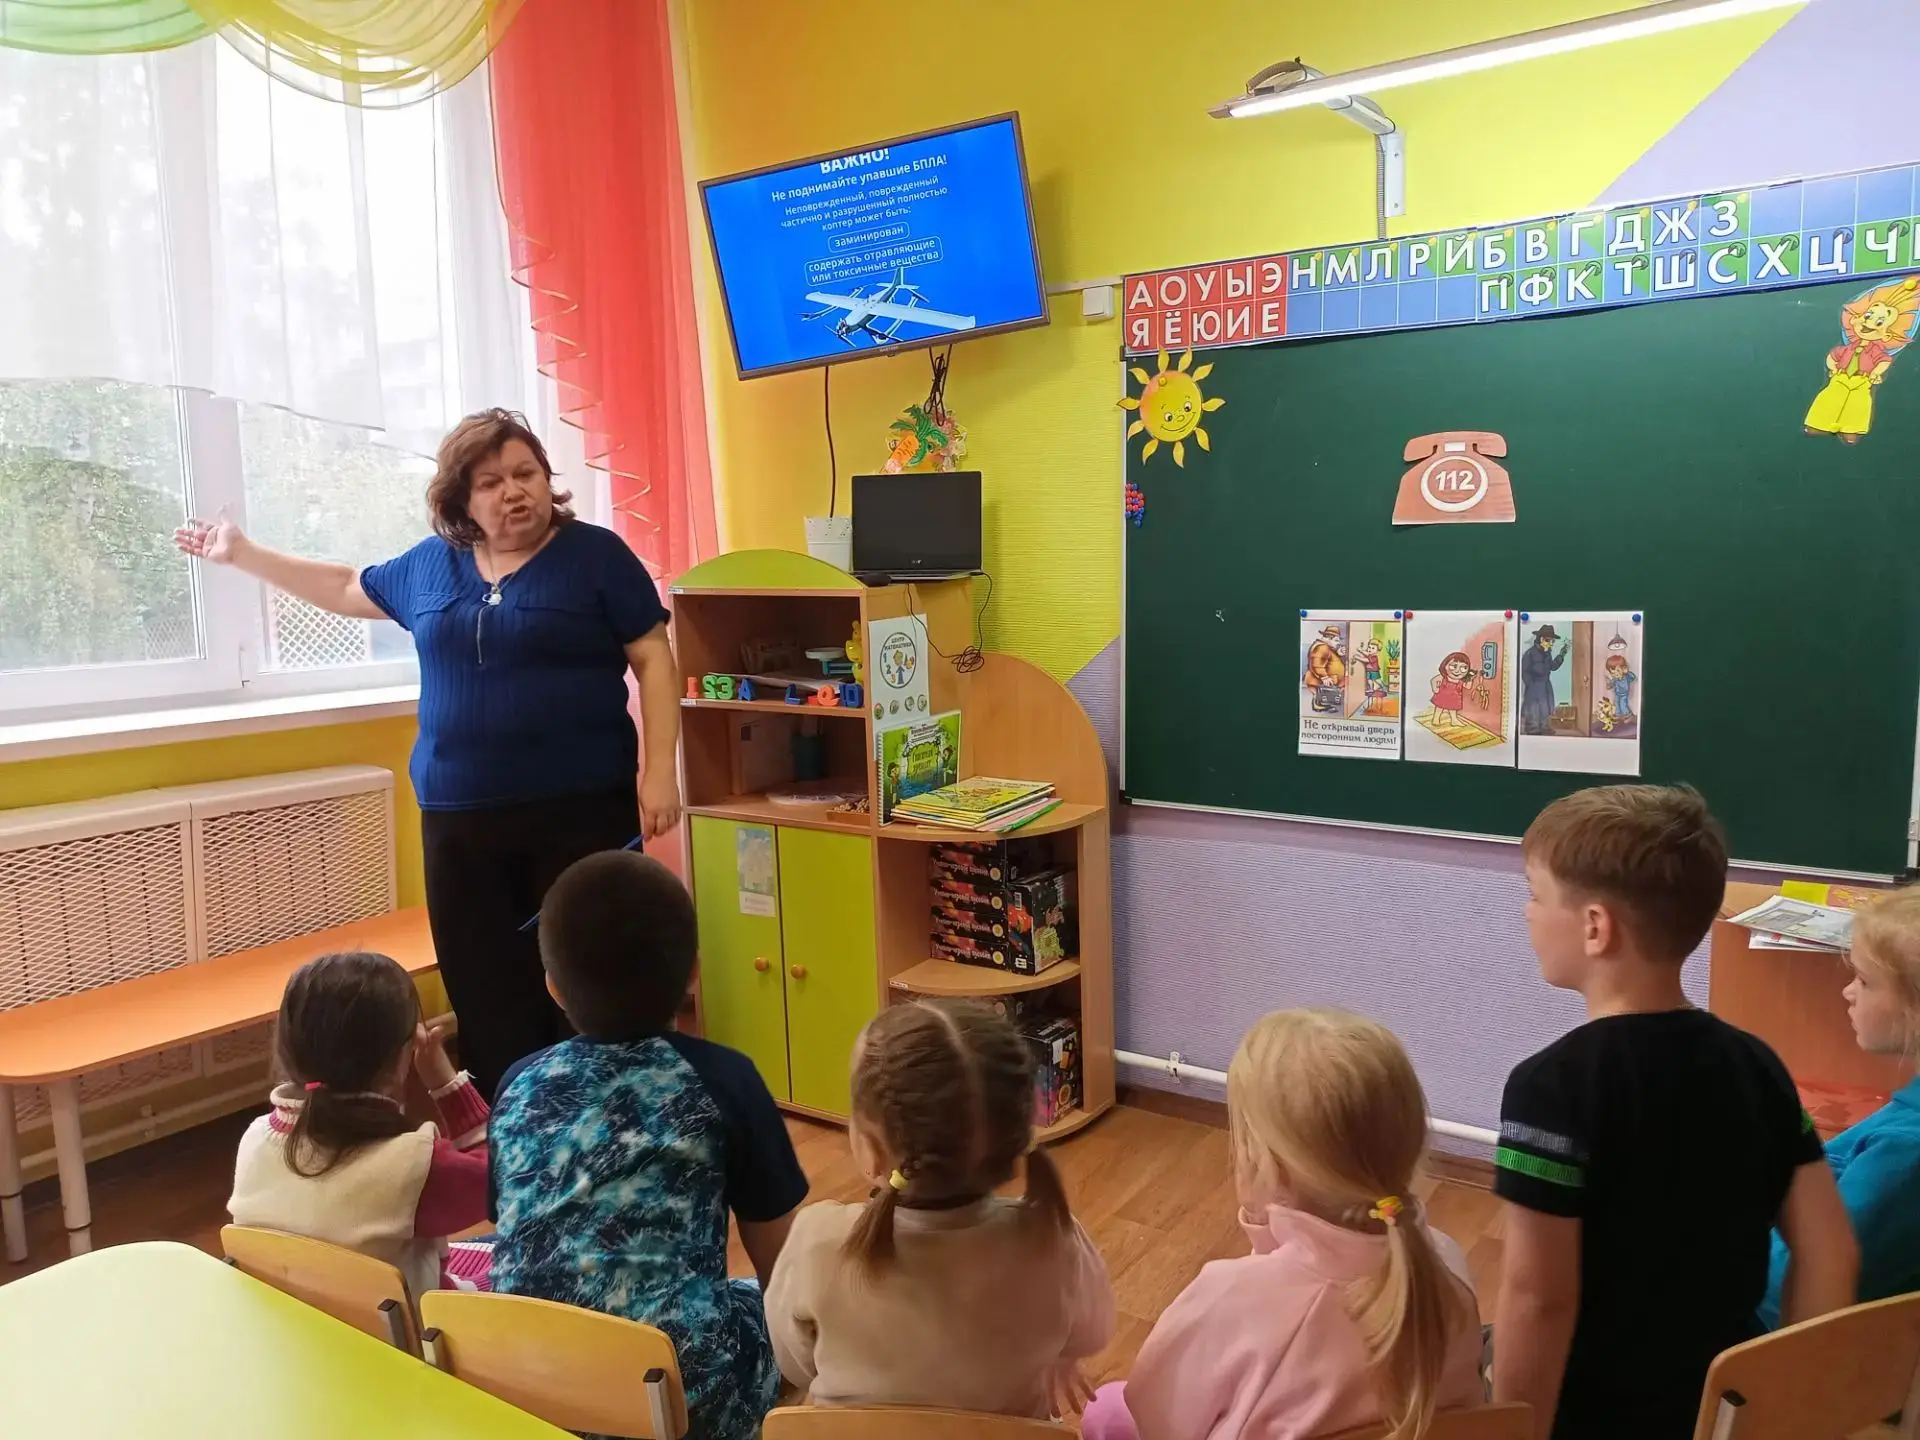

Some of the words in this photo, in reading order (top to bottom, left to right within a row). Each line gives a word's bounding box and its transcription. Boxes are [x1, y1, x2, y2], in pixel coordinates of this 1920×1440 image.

[820, 148, 890, 174] ВАЖНО!
[772, 190, 786, 202] Не
[788, 175, 858, 199] поднимайте
[859, 163, 911, 186] упавшие
[913, 154, 947, 172] БПЛА!
[781, 213, 822, 228] частично
[824, 210, 831, 219] и
[832, 197, 895, 219] разрушенный
[897, 187, 948, 204] полностью
[785, 191, 867, 216] Неповрежденный,
[869, 175, 939, 199] поврежденный
[822, 216, 853, 232] коптер
[855, 212, 884, 225] может
[886, 206, 912, 218] быть:
[835, 226, 904, 248] заминирован
[808, 254, 862, 273] содержать
[864, 239, 936, 261] отравляющие
[812, 272, 831, 283] или
[833, 262, 888, 279] токсичные
[890, 251, 939, 267] вещества
[1435, 470, 1475, 491] 112
[1301, 732, 1361, 742] посторонним
[1363, 737, 1397, 745] людям!
[1304, 720, 1319, 729] Не
[1321, 723, 1365, 733] открывай
[1367, 726, 1395, 735] дверь
